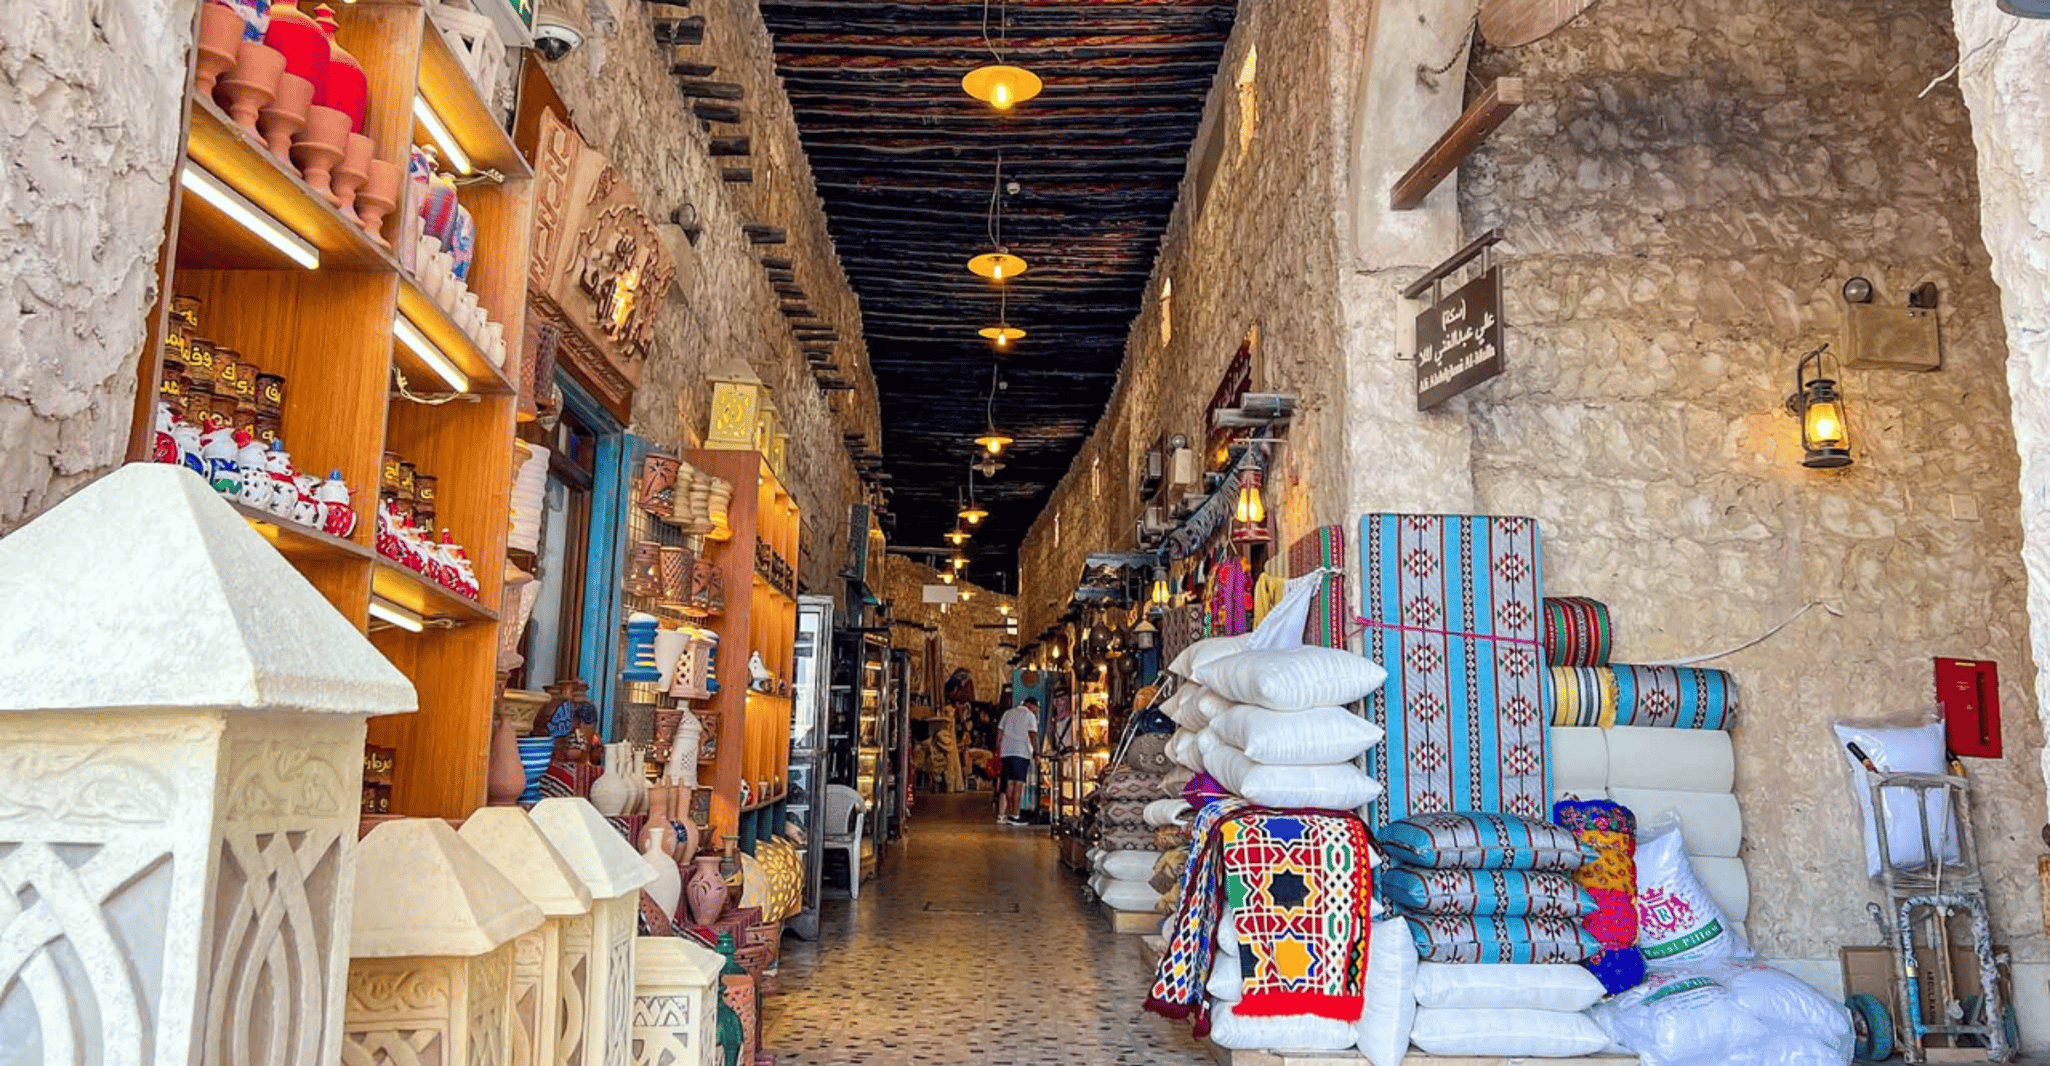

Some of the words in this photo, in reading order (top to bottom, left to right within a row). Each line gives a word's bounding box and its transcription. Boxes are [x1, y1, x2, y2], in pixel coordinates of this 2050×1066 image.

[1475, 311, 1495, 345] علي
[1657, 907, 1672, 923] R
[1682, 925, 1719, 946] Pillow
